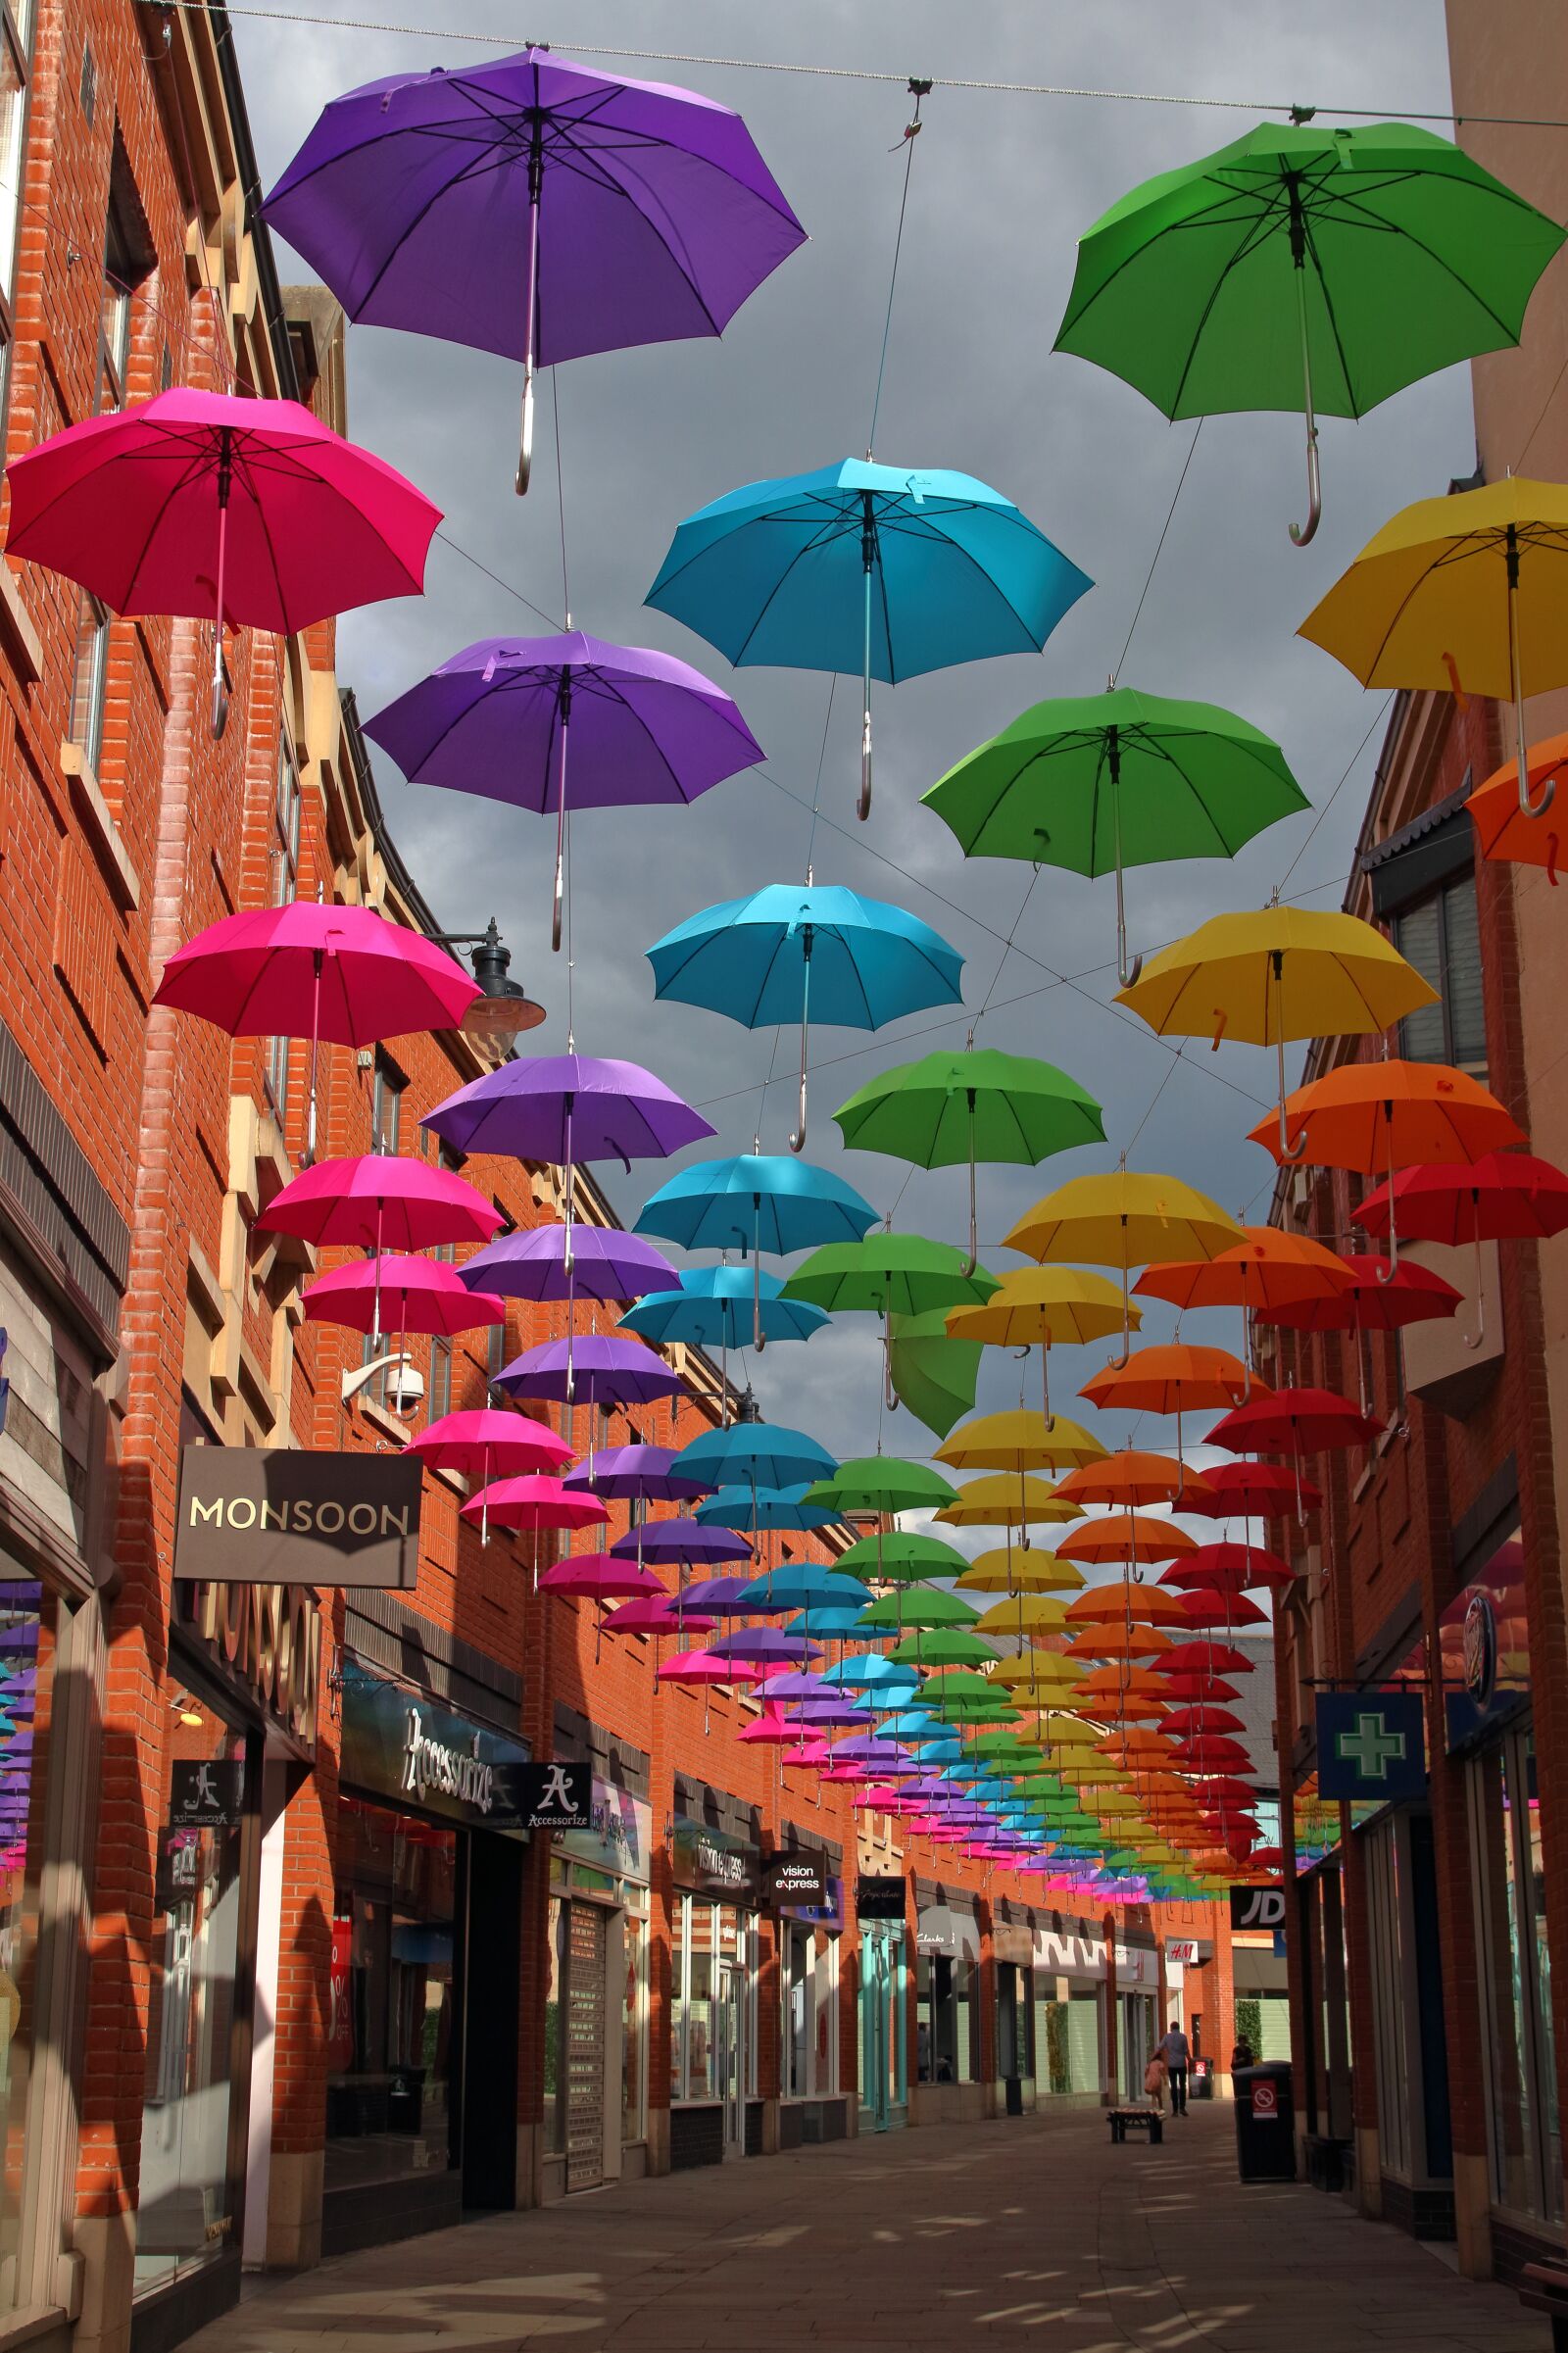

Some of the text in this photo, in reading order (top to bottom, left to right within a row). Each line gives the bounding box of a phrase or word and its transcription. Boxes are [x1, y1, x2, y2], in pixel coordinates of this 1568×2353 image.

[189, 1495, 409, 1536] MONSOON
[403, 1707, 493, 1814] Accessorize
[537, 1765, 579, 1812] A
[527, 1813, 588, 1827] Accessorize
[782, 1865, 813, 1877] vision
[775, 1879, 820, 1891] express
[1240, 1890, 1287, 1925] JD
[916, 1933, 945, 1943] Clarks
[1171, 1943, 1194, 1959] H&M
